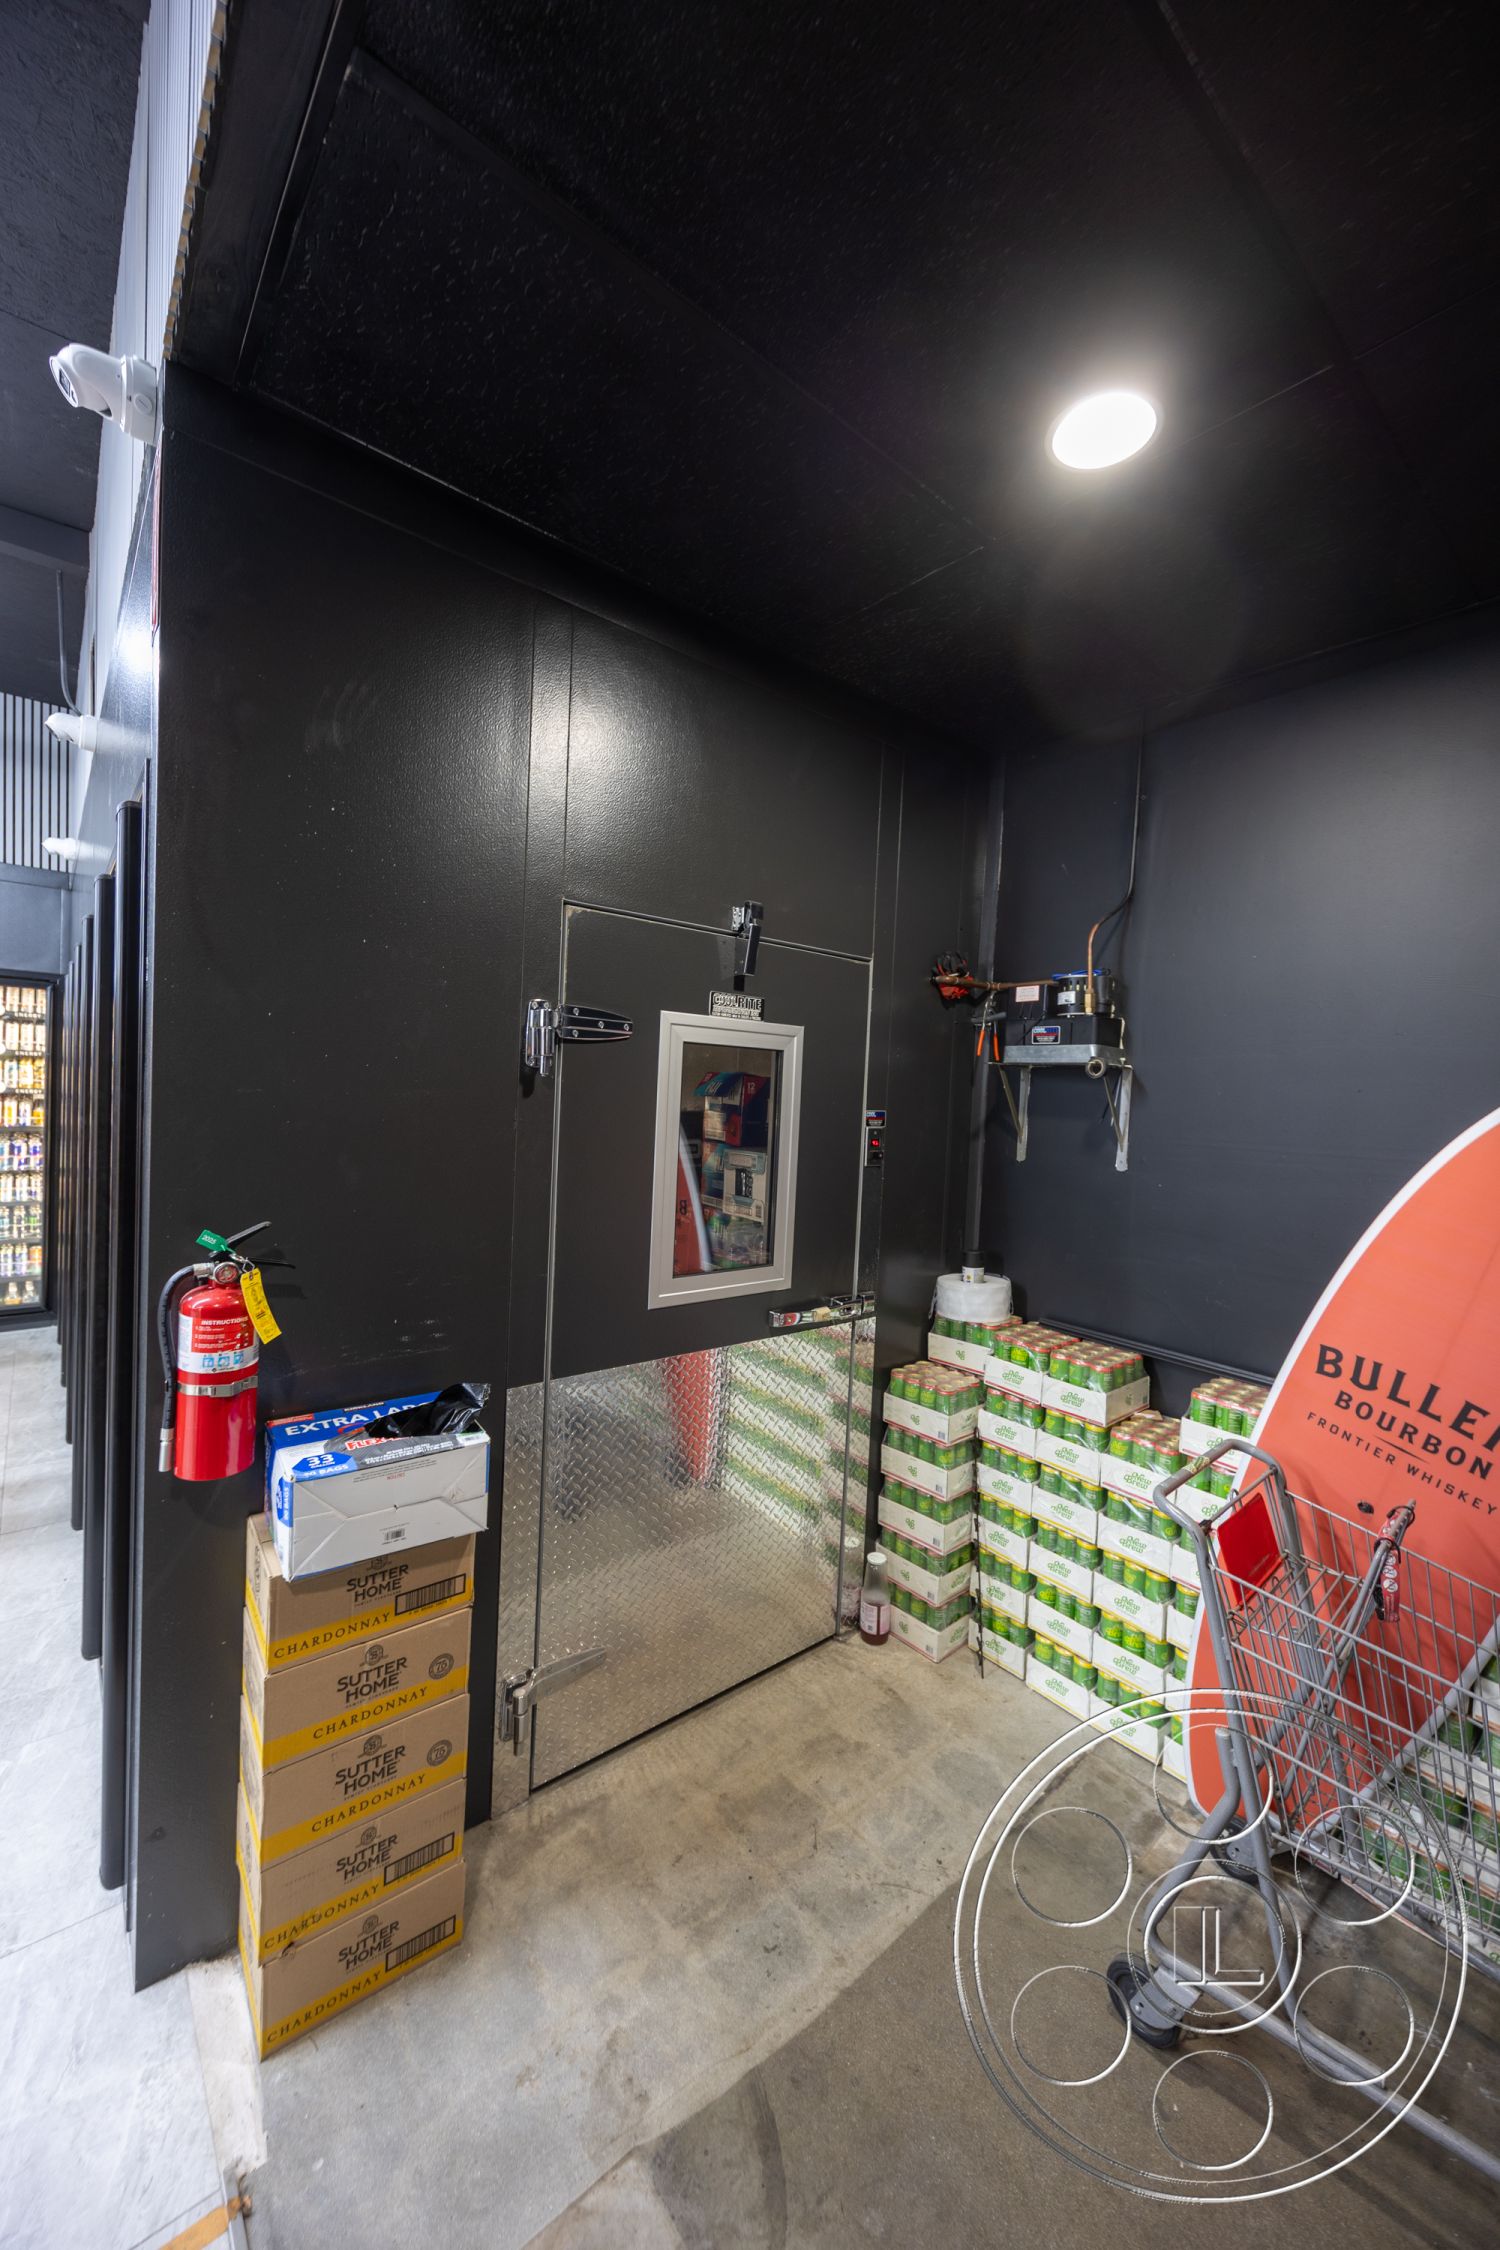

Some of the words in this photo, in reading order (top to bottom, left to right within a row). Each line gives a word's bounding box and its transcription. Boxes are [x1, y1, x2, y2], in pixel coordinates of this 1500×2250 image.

[284, 1414, 369, 1436] EXTRA
[1334, 1390, 1494, 1480] BOURBON
[306, 1454, 334, 1467] 33
[1307, 1411, 1396, 1465] FRONTIER
[1406, 1463, 1497, 1515] WHISKEY
[346, 1564, 411, 1592] SUTTER
[353, 1580, 402, 1603] HOME
[274, 1612, 391, 1659] CHARDONNAY
[336, 1656, 408, 1693] SUTTER
[344, 1675, 400, 1704] HOME
[313, 1686, 428, 1740] CHARDONNAY
[335, 1745, 407, 1785] SUTTER
[343, 1762, 398, 1796] HOME
[311, 1774, 426, 1833] CHARDONNAY
[335, 1834, 398, 1873] SUTTER
[343, 1851, 391, 1881] HOME
[264, 1884, 379, 1949] CHARDONNAY
[338, 1920, 400, 1963] SUTTER
[346, 1937, 392, 1970] HOME
[267, 1970, 381, 2044] CHARDONNAY
